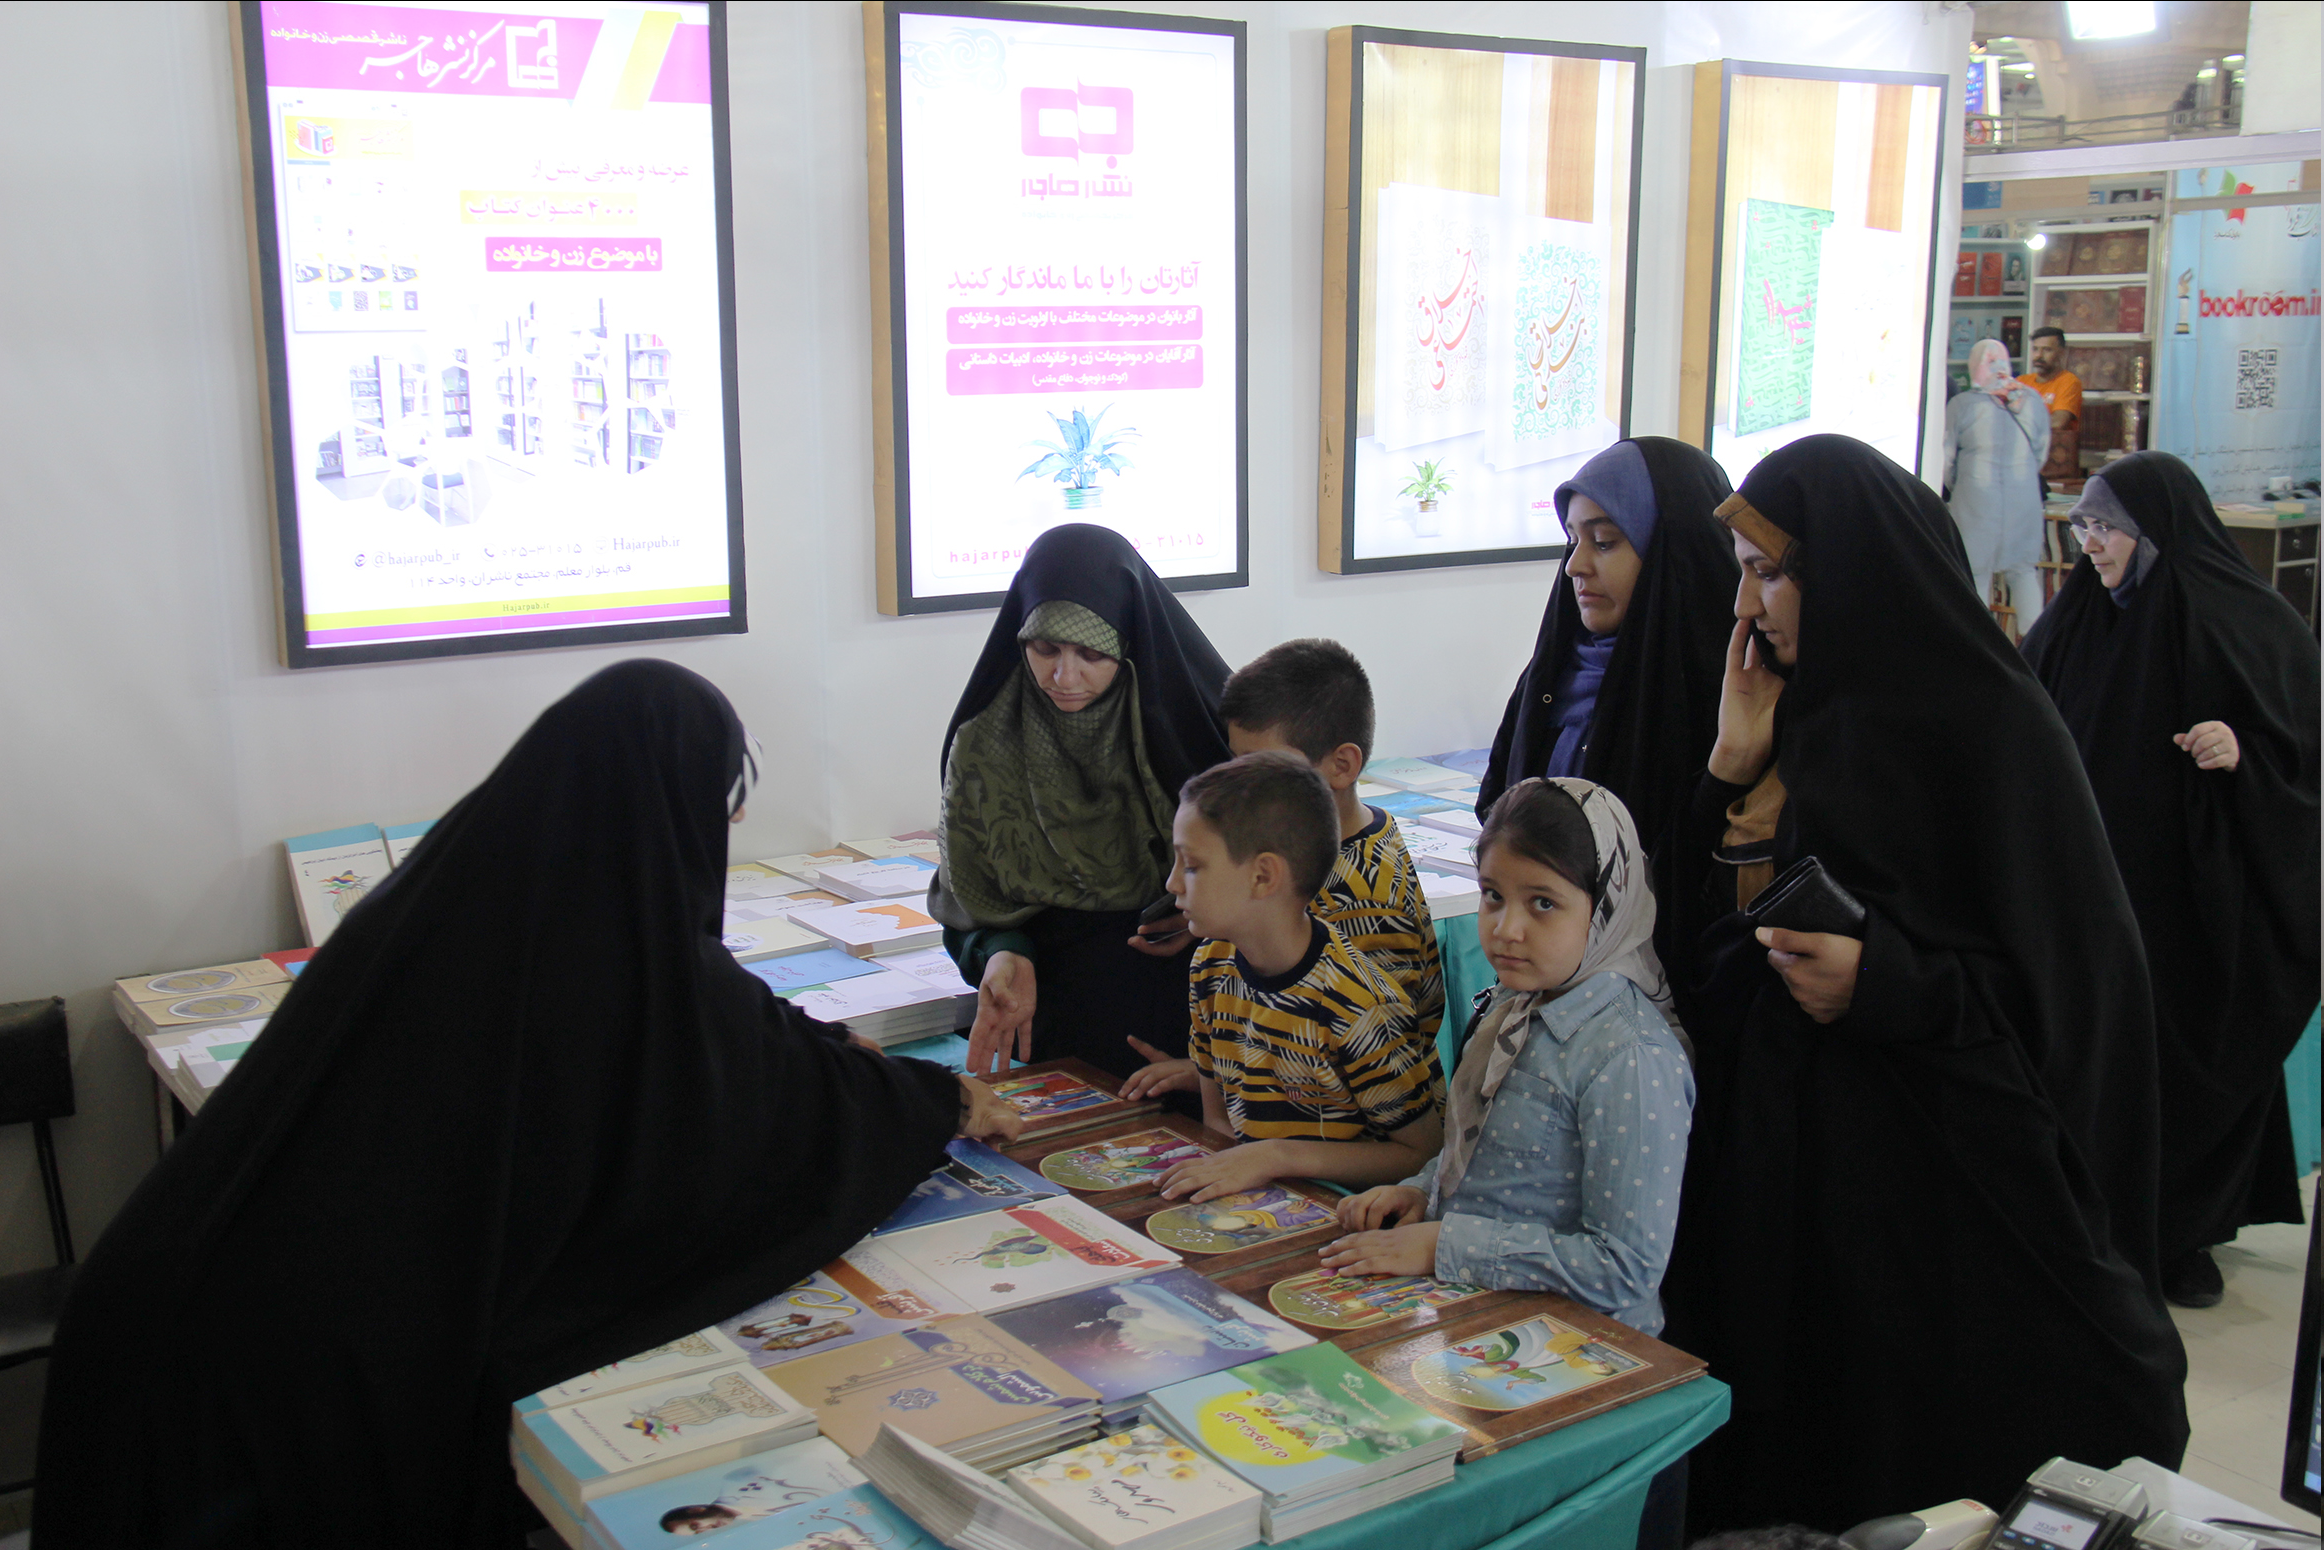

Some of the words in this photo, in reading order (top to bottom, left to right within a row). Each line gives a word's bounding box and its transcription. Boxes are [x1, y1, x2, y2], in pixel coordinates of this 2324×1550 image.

[270, 28, 311, 41] خانواده
[379, 32, 407, 47] ناشر
[468, 198, 522, 220] کتاب
[525, 200, 584, 222] عنوان
[492, 245, 550, 269] خانواده
[550, 249, 560, 267] و
[562, 246, 585, 266] زن
[587, 246, 645, 269] موضوع
[645, 245, 658, 266] با
[947, 266, 993, 297] کنید
[995, 264, 1067, 296] ماندگار
[1073, 264, 1093, 290] ما
[1100, 264, 1114, 296] با
[1120, 265, 1133, 296] را
[1139, 260, 1202, 296] آثارتان
[958, 311, 994, 330] خانواده
[993, 313, 1001, 328] و
[1002, 311, 1016, 327] زن
[1017, 310, 1049, 328] اولویت
[1049, 310, 1058, 326] با
[1058, 310, 1097, 324] مختلف
[1098, 310, 1145, 327] موضوعات
[1144, 311, 1156, 325] در
[1157, 309, 1183, 327] بانوان
[1182, 307, 1198, 324] آثار
[959, 352, 998, 371] داستانی
[999, 351, 1031, 367] ادبیات
[1070, 353, 1077, 367] و
[1079, 350, 1093, 366] زن
[1094, 349, 1142, 367] موضوعات
[1142, 350, 1154, 364] در
[1180, 346, 1197, 363] آثار
[613, 535, 681, 552] Hajarpub.ir
[514, 570, 550, 587] مجتمع
[585, 564, 611, 579] بلوار
[438, 574, 466, 587] واحد
[502, 600, 551, 613] Hajarpub.ir
